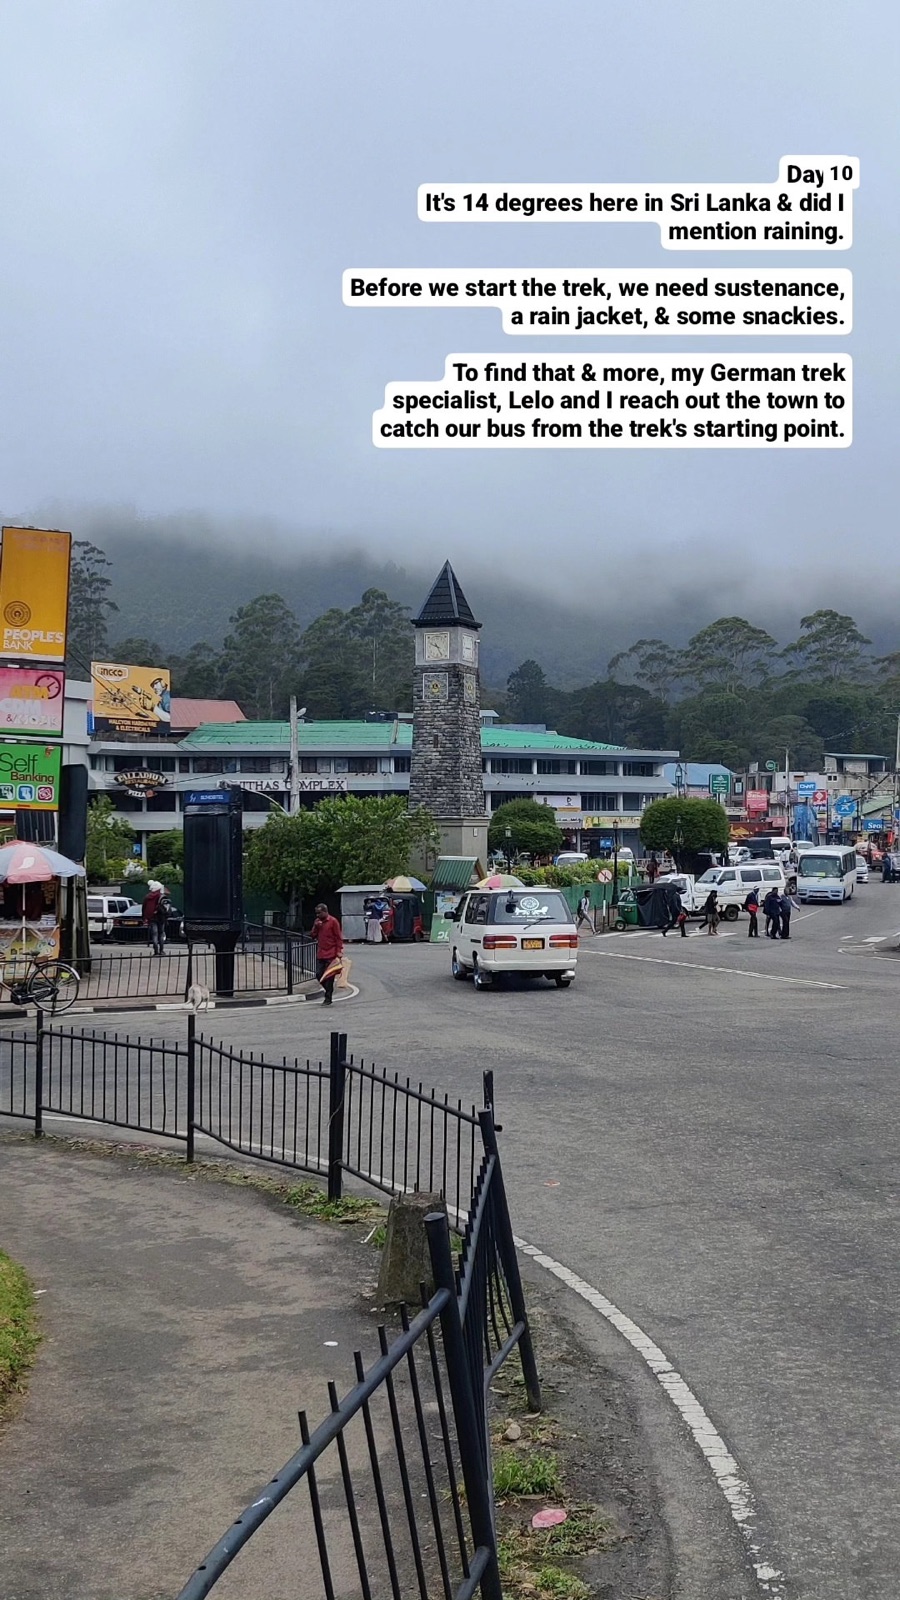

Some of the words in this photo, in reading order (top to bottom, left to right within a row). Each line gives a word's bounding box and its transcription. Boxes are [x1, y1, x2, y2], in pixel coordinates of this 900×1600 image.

[3, 639, 33, 651] BANK
[0, 752, 38, 774] Self
[11, 771, 54, 784] Banking
[128, 789, 146, 798] PIZZA
